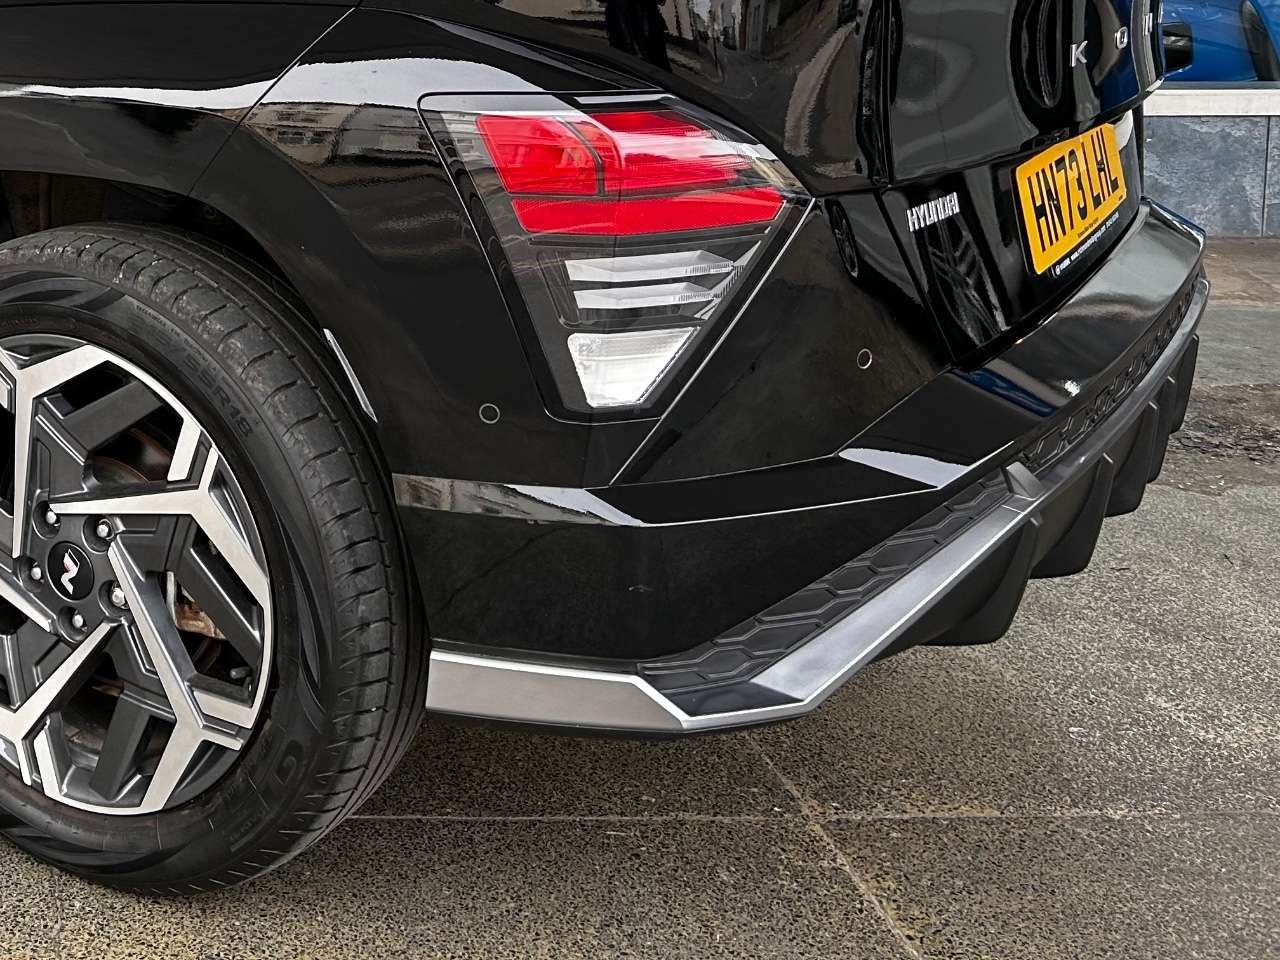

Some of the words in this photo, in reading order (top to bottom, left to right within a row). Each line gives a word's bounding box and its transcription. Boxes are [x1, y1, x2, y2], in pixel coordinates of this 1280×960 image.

[906, 191, 960, 233] HYUNDAI
[1026, 148, 1089, 253] HN73
[1080, 127, 1120, 211] LHL
